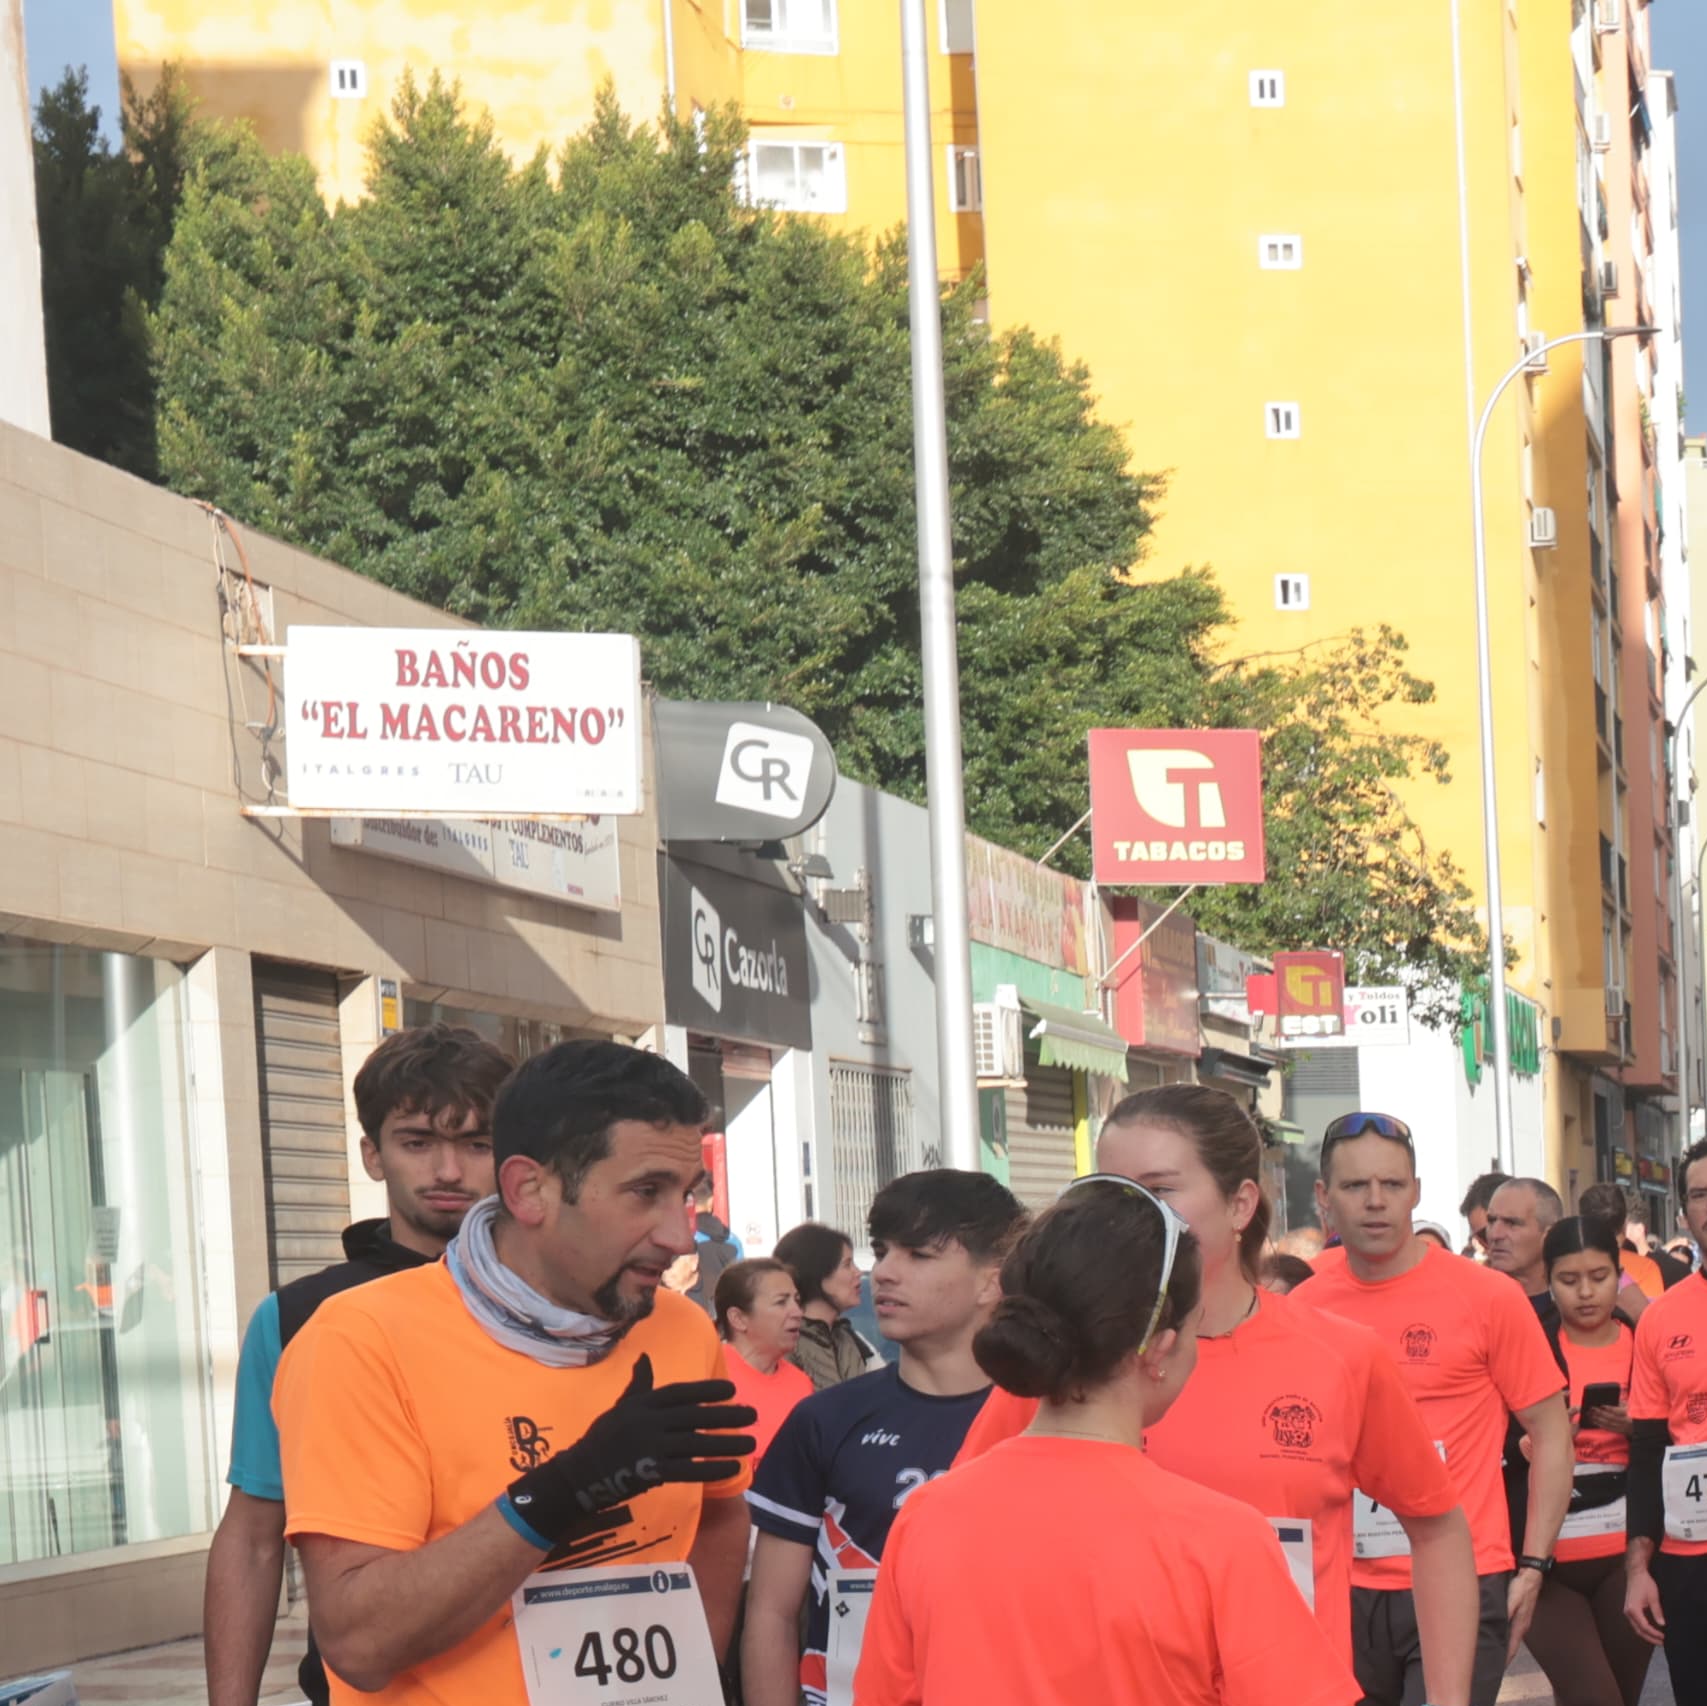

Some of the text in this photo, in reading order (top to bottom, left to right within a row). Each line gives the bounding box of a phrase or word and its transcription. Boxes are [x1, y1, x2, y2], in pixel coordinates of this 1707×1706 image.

[395, 639, 530, 690] BAÑOS
[448, 762, 503, 784] TAU
[1113, 840, 1245, 861] TABACOS
[724, 927, 789, 997] Cazorla
[1359, 991, 1400, 1001] Toldos
[574, 1624, 678, 1686] 480
